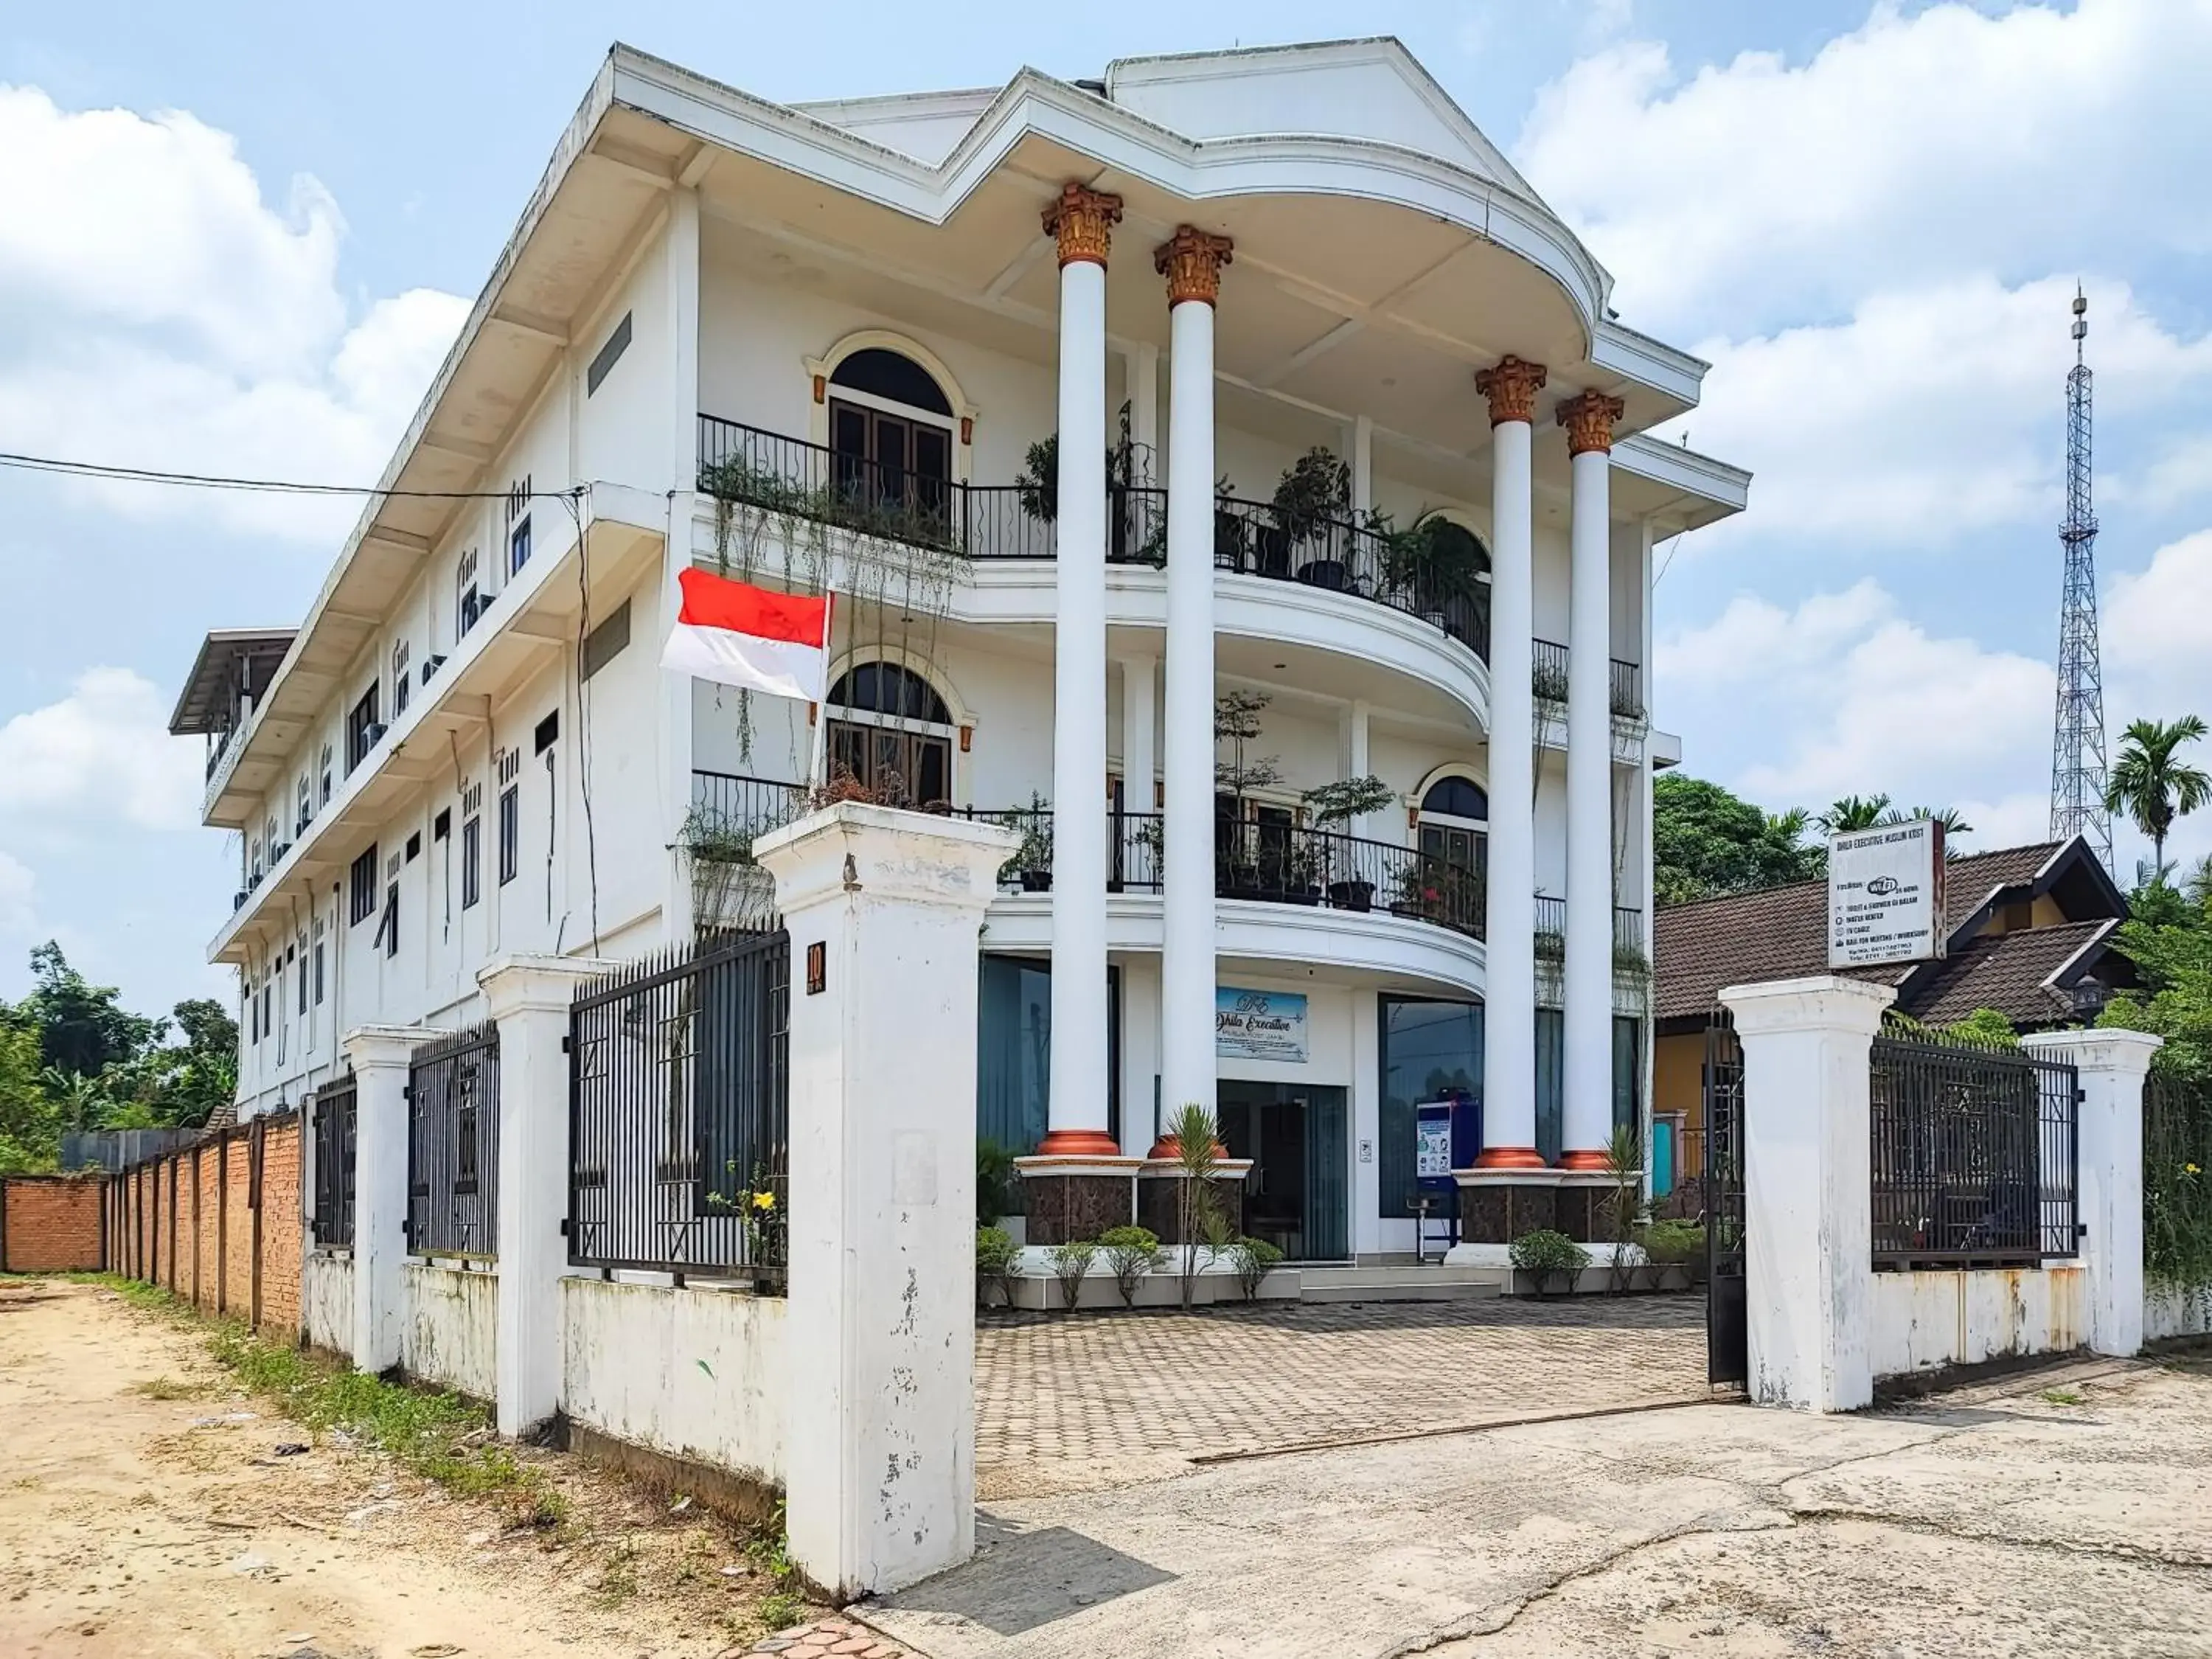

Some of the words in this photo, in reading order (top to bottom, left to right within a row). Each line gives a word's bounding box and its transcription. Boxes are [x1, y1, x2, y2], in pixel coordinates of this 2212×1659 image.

[1853, 835, 1884, 849] EXECUTIVE
[1908, 827, 1924, 839] KOST
[810, 945, 822, 981] 10
[1245, 1015, 1292, 1032] Executive
